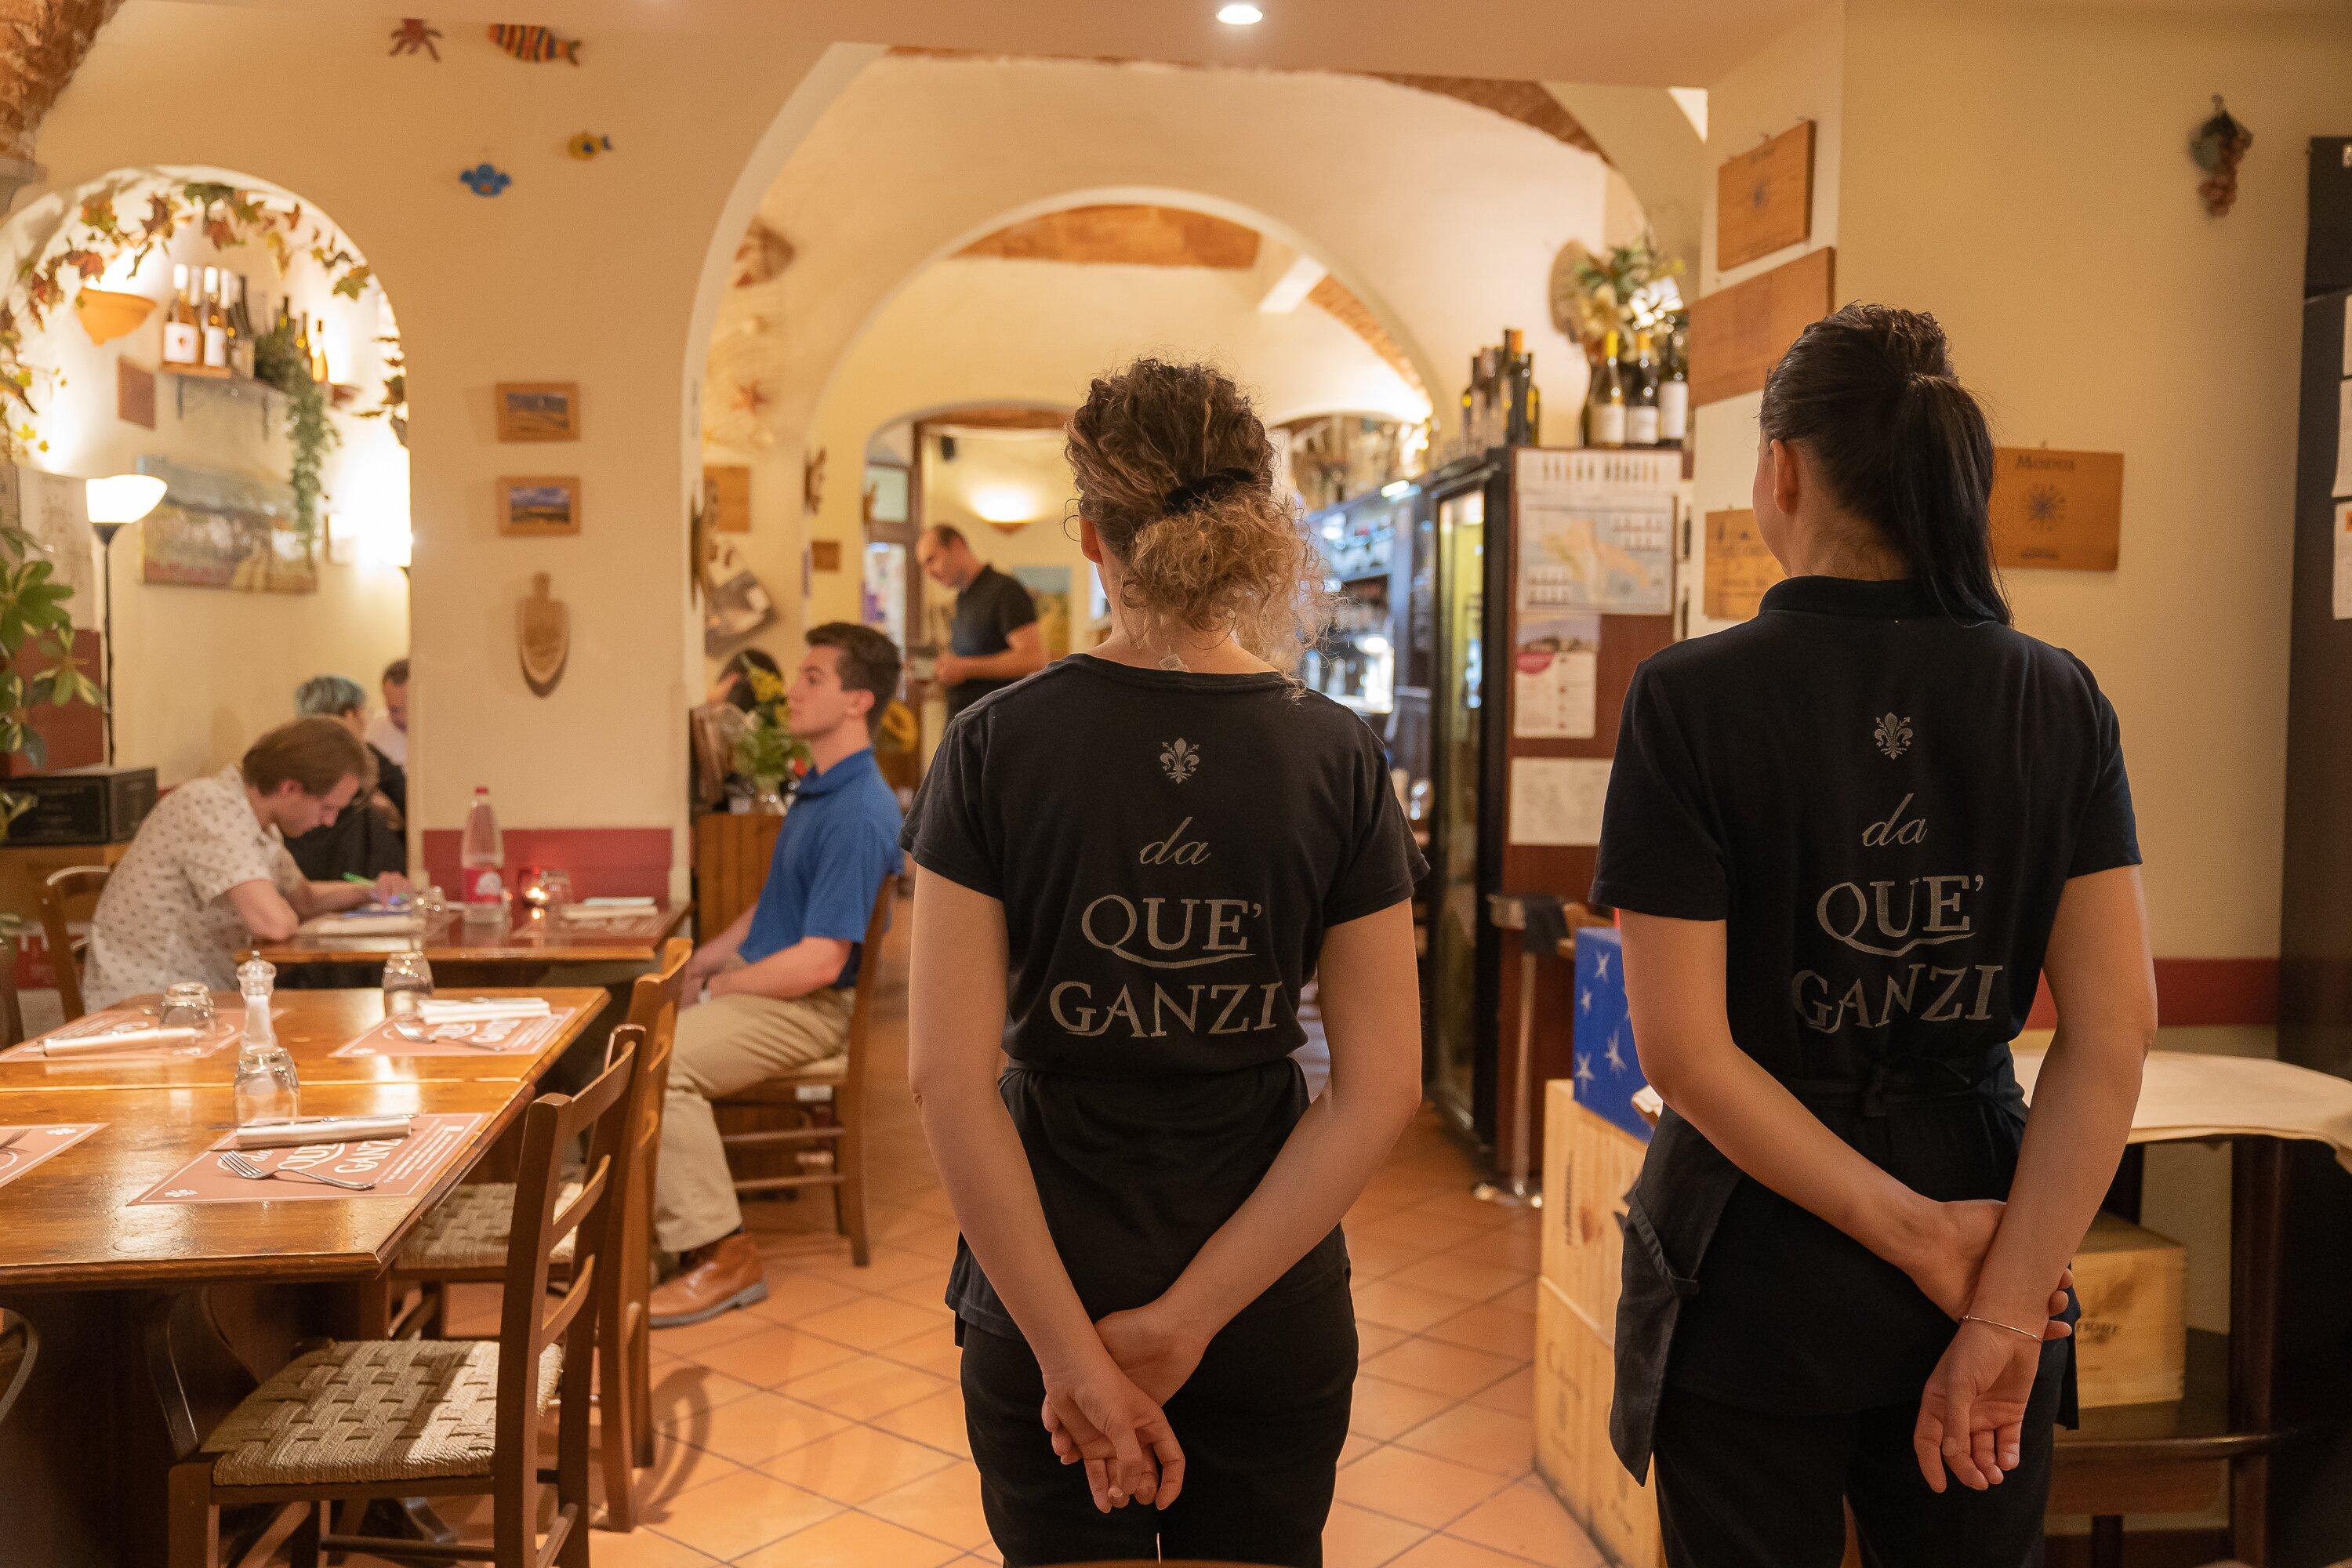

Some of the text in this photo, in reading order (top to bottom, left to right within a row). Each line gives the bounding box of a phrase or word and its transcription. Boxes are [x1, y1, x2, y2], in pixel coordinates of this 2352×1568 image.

[1139, 816, 1211, 865] da
[1861, 792, 1928, 848] da
[1048, 980, 1283, 1039] GANZI
[1791, 963, 2004, 1034] GANZI
[333, 1138, 404, 1174] GANZ
